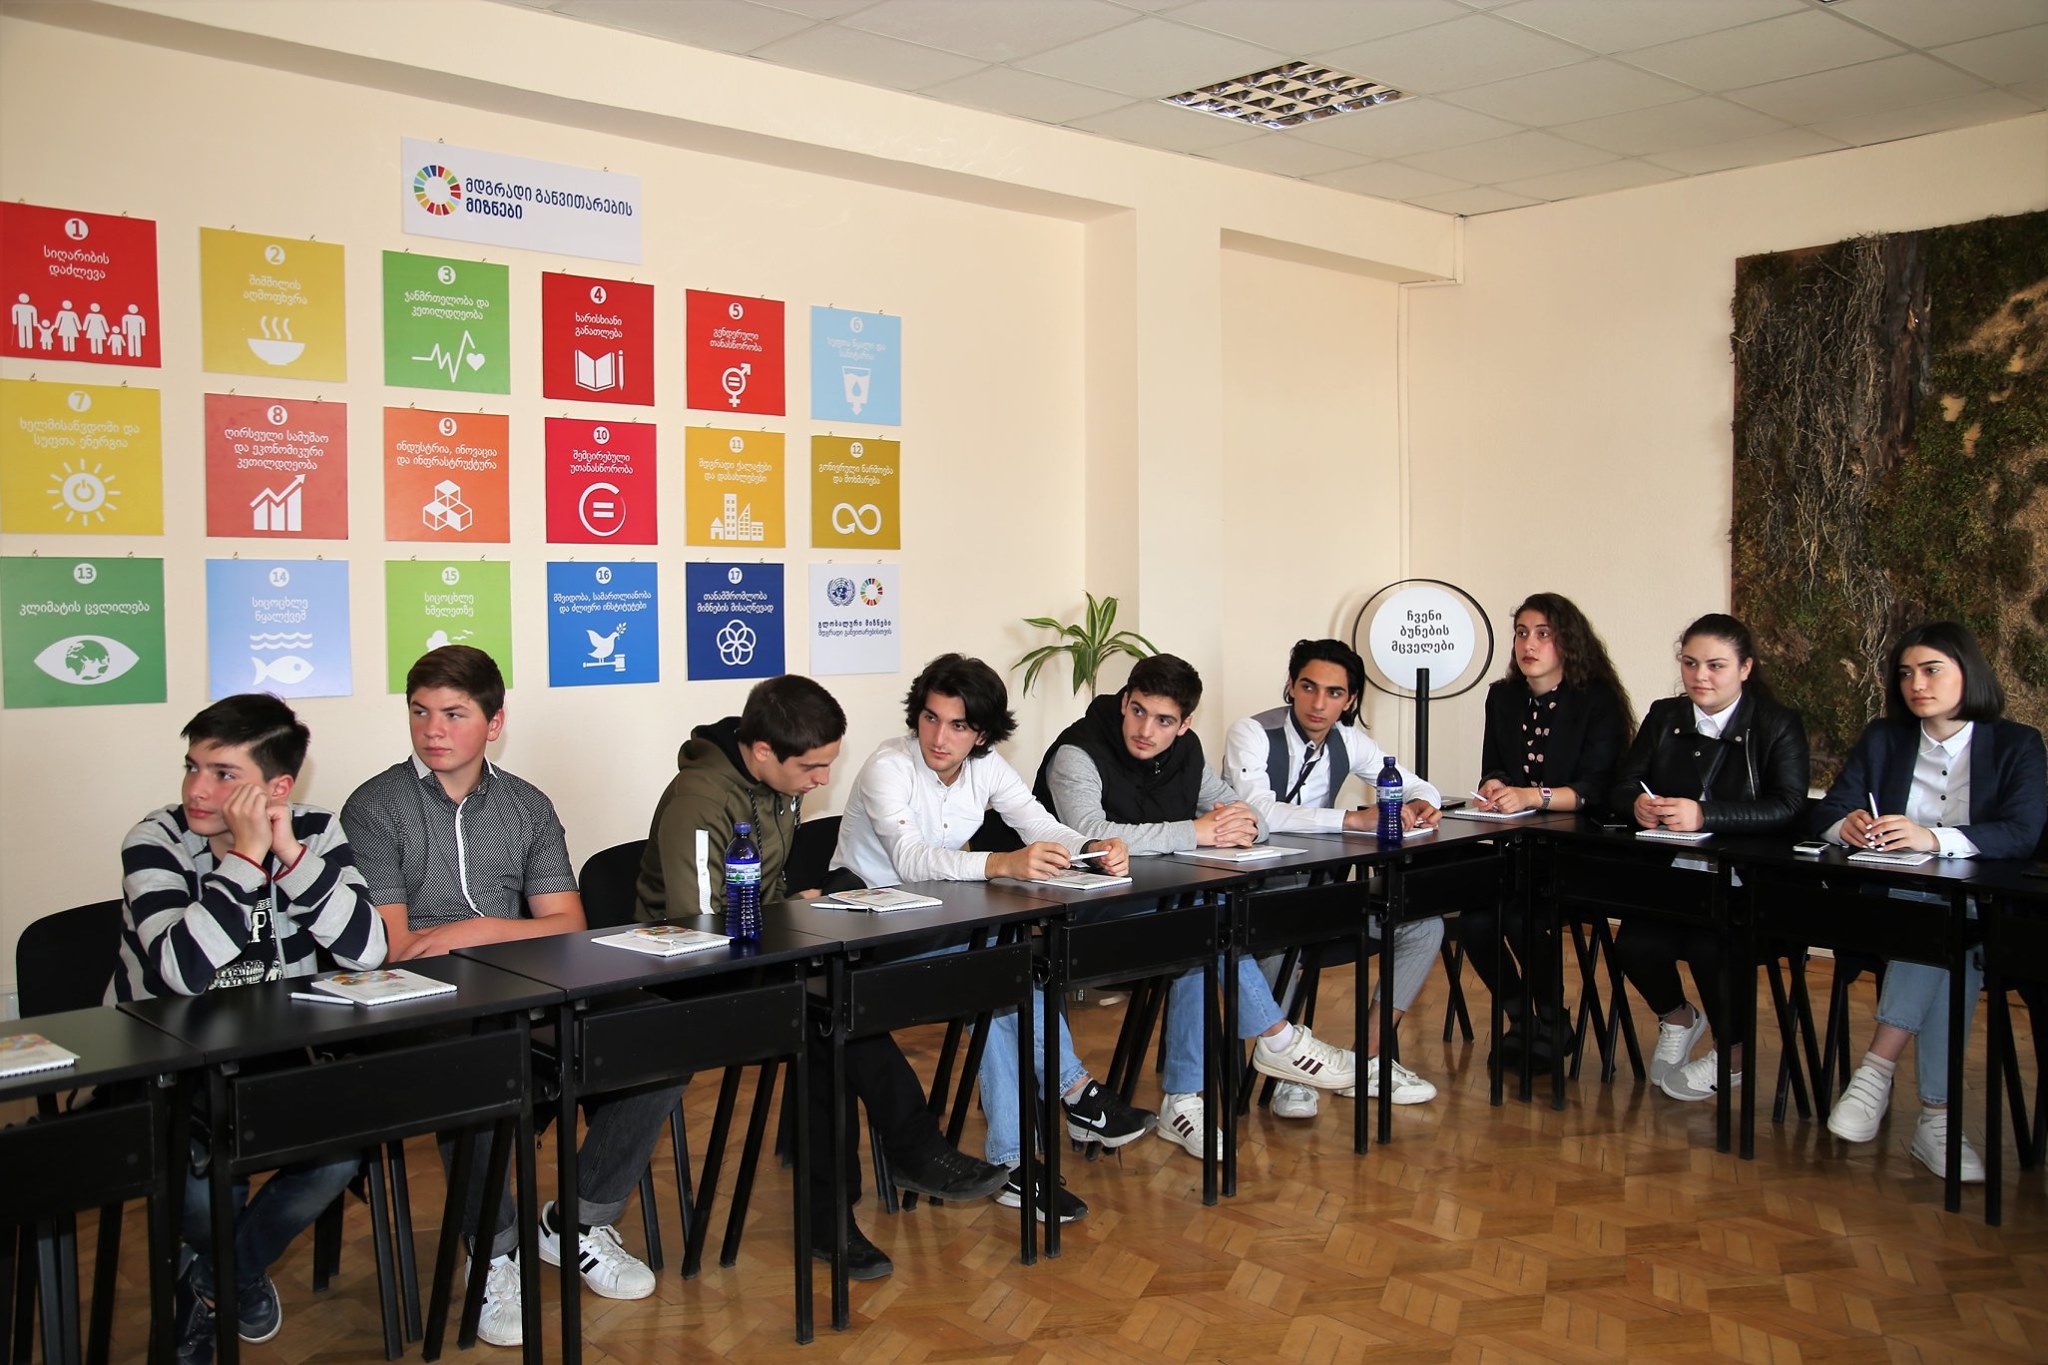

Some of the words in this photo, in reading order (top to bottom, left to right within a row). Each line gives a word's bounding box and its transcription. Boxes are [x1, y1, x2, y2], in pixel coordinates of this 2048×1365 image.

[465, 177, 532, 201] მდგრადი
[535, 188, 633, 216] განვითარების
[466, 197, 523, 220] მიზნები
[44, 244, 110, 264] სიღარიბის
[49, 263, 106, 281] დაძლევა
[249, 273, 301, 291] შიმშილის
[243, 288, 308, 306] აღმოფხვრა
[404, 290, 474, 306] ჯანმრთელობა
[476, 299, 490, 310] და
[412, 306, 484, 321] კეთილდღეობა
[576, 312, 622, 326] ხარისხიანი
[576, 325, 623, 340] განათლება
[714, 326, 759, 342] გენდერული
[123, 424, 140, 436] და
[224, 427, 284, 442] ღირსეული
[286, 430, 329, 444] სამუშაო
[33, 433, 76, 448] სუფთა
[80, 435, 128, 450] ენერგია
[234, 444, 249, 454] და
[252, 442, 324, 458] ეკონომიკური
[455, 444, 498, 458] ინოვაცია
[572, 450, 631, 464] შემცირებული
[236, 458, 318, 472] კეთილდღეობა
[396, 456, 410, 466] და
[412, 454, 497, 472] ინფრასტრუქტურა
[570, 462, 634, 474] უთანასწორობა
[832, 476, 842, 484] და
[252, 596, 308, 610] სიცოცხლე
[424, 592, 474, 604] სიცოცხლე
[592, 590, 652, 602] სამართლიანობა
[703, 590, 768, 602] თანამშრომლობა
[20, 600, 80, 616] კლიმატის
[84, 600, 150, 616] ცვლილება
[425, 604, 474, 618] ხმელეთზე
[559, 606, 570, 614] და
[572, 603, 601, 614] ძლიერი
[696, 602, 729, 614] მიზნების
[730, 602, 774, 614] მისაღწევად
[1407, 609, 1442, 624] ჩვენი
[1400, 624, 1450, 640] ბუნების
[1391, 640, 1455, 654] მცველები
